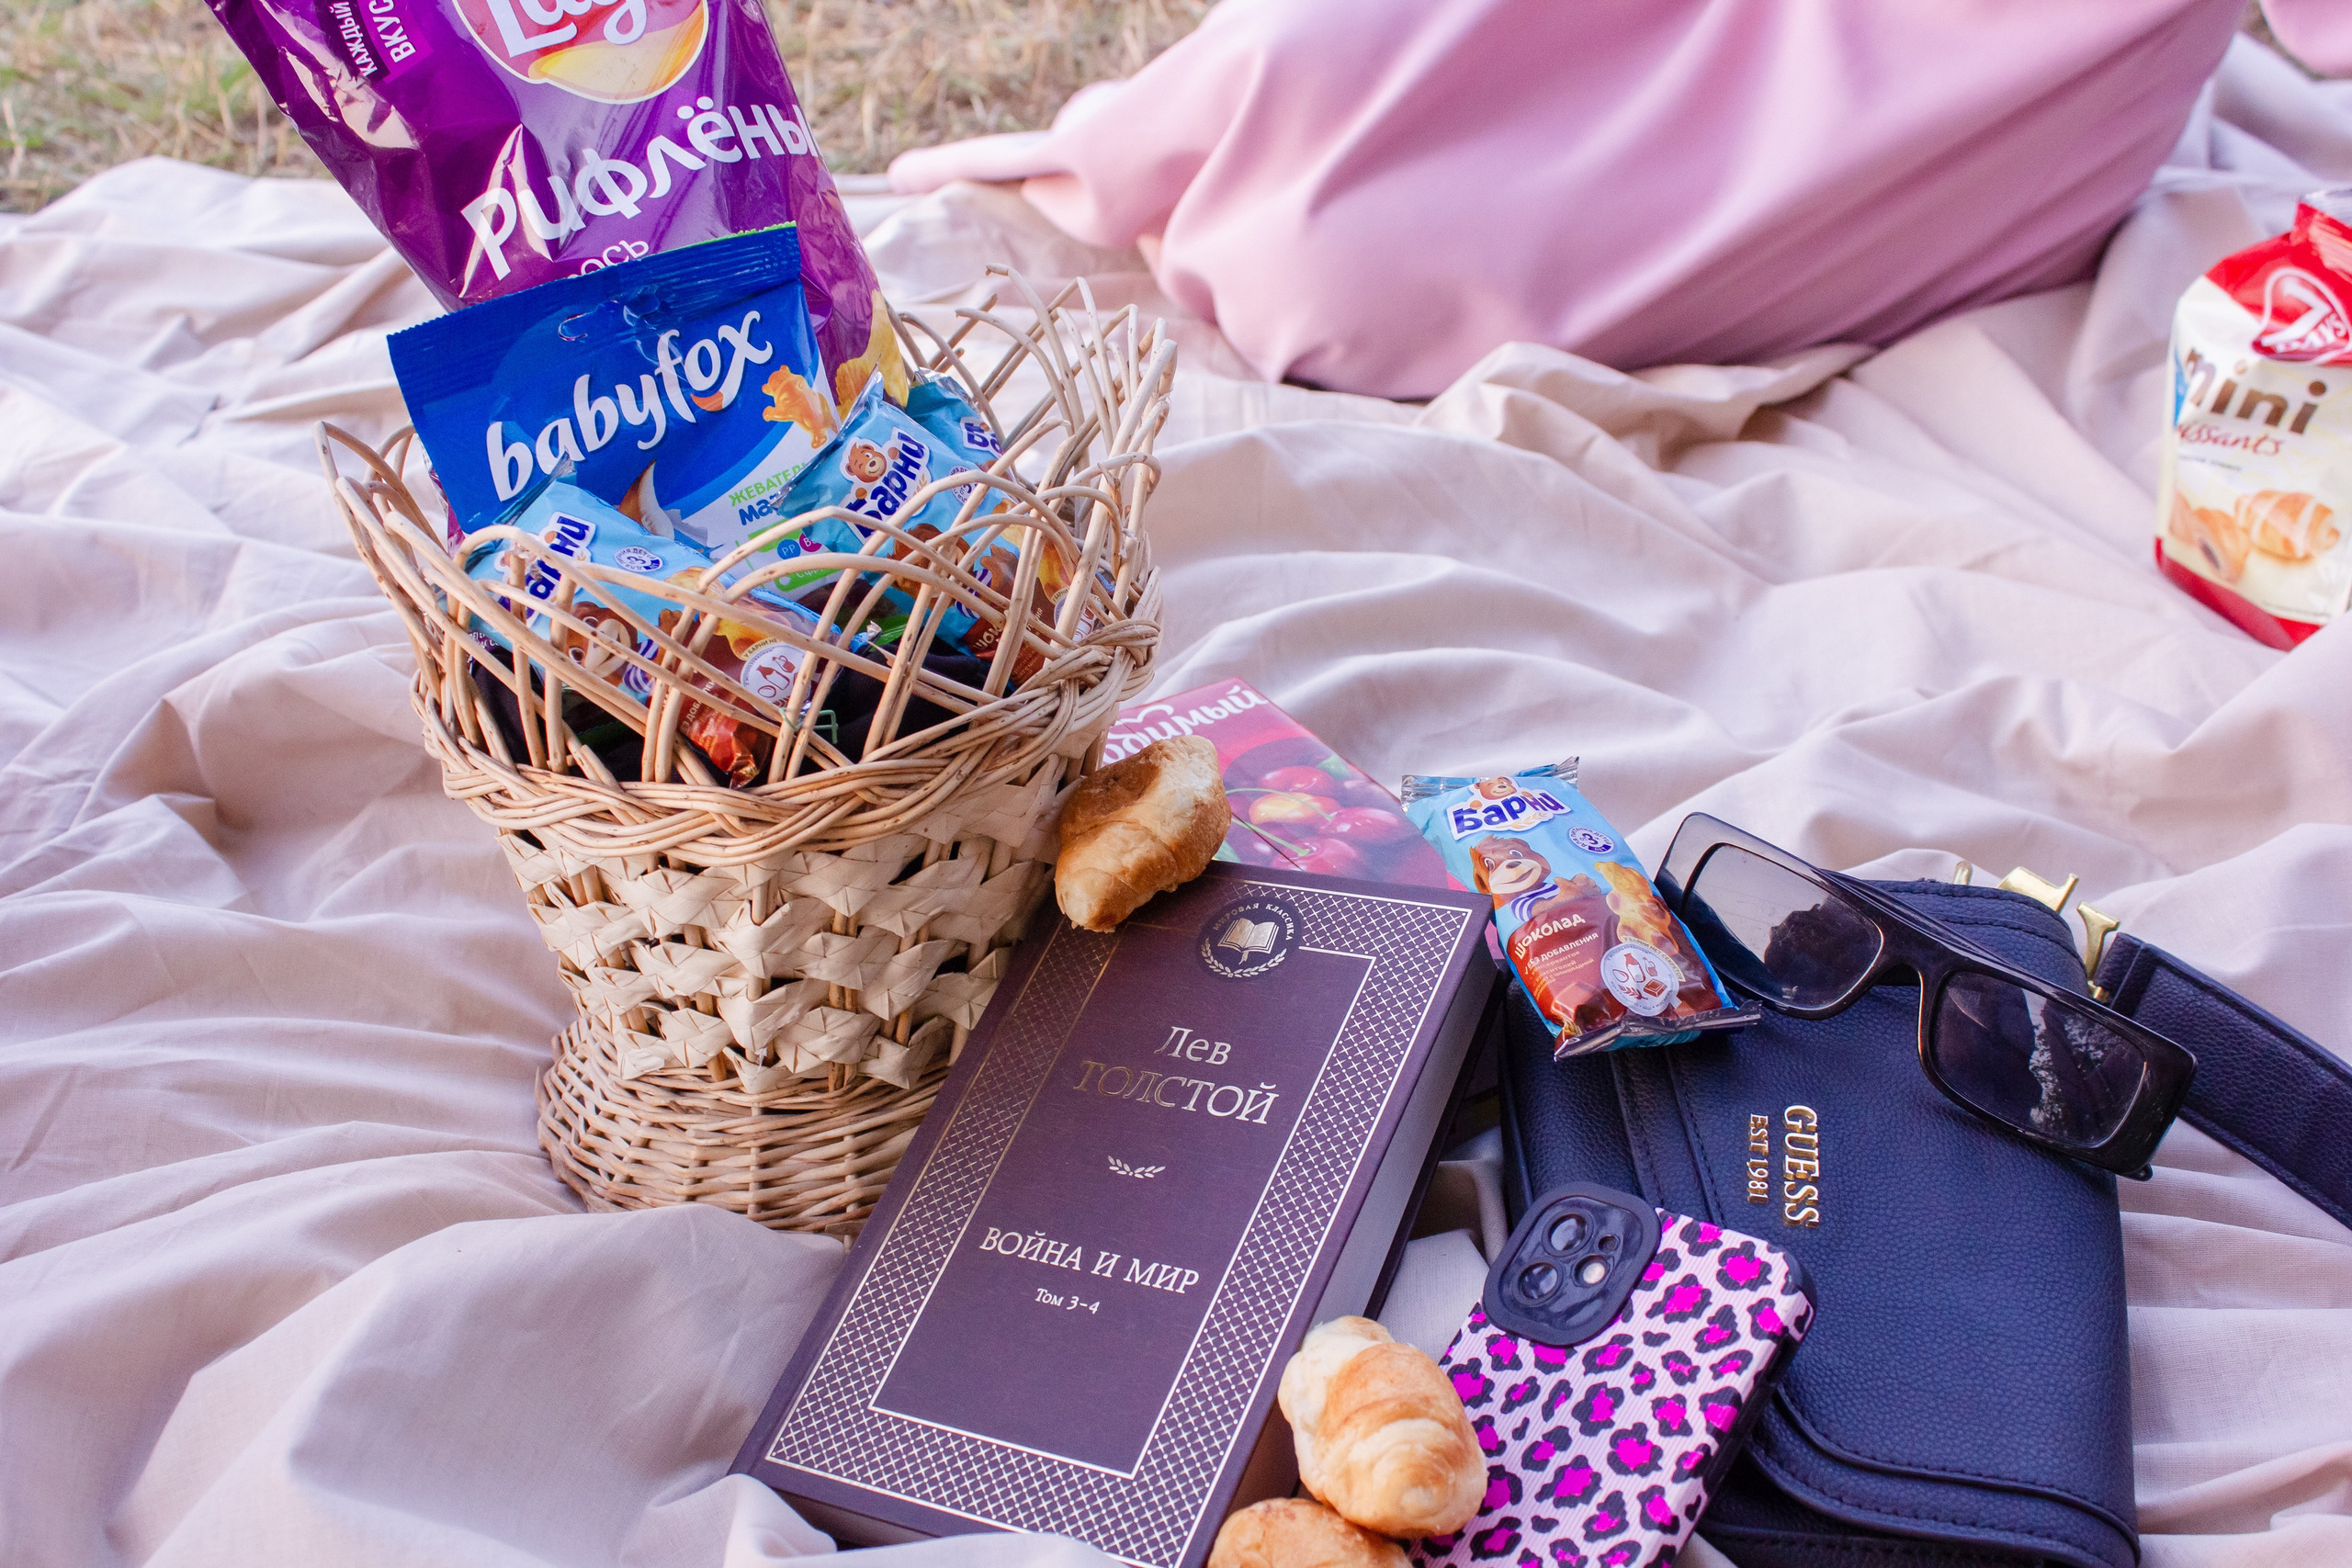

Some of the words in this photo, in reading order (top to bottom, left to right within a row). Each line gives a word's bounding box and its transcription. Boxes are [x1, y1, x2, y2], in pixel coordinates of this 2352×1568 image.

[330, 1, 378, 77] КАЖДЫЙ
[486, 310, 773, 502] babyfox
[1452, 792, 1566, 834] Барни
[1212, 902, 1260, 931] МИРОВАЯ
[1265, 903, 1295, 941] КЛАССИКА
[1541, 932, 1600, 962] ДОБАВЛЕНИЯ
[1153, 1025, 1232, 1066] Лев
[1072, 1059, 1280, 1124] ТОЛСТОЙ
[1748, 1112, 1770, 1155] EST
[1746, 1157, 1770, 1202] 1981
[1783, 1104, 1820, 1226] GUESS
[978, 1226, 1082, 1271] ВОЙНА
[1091, 1250, 1122, 1279] И
[1123, 1258, 1200, 1294] МИР
[1035, 1287, 1065, 1307] Том
[1066, 1295, 1101, 1314] 3-4
